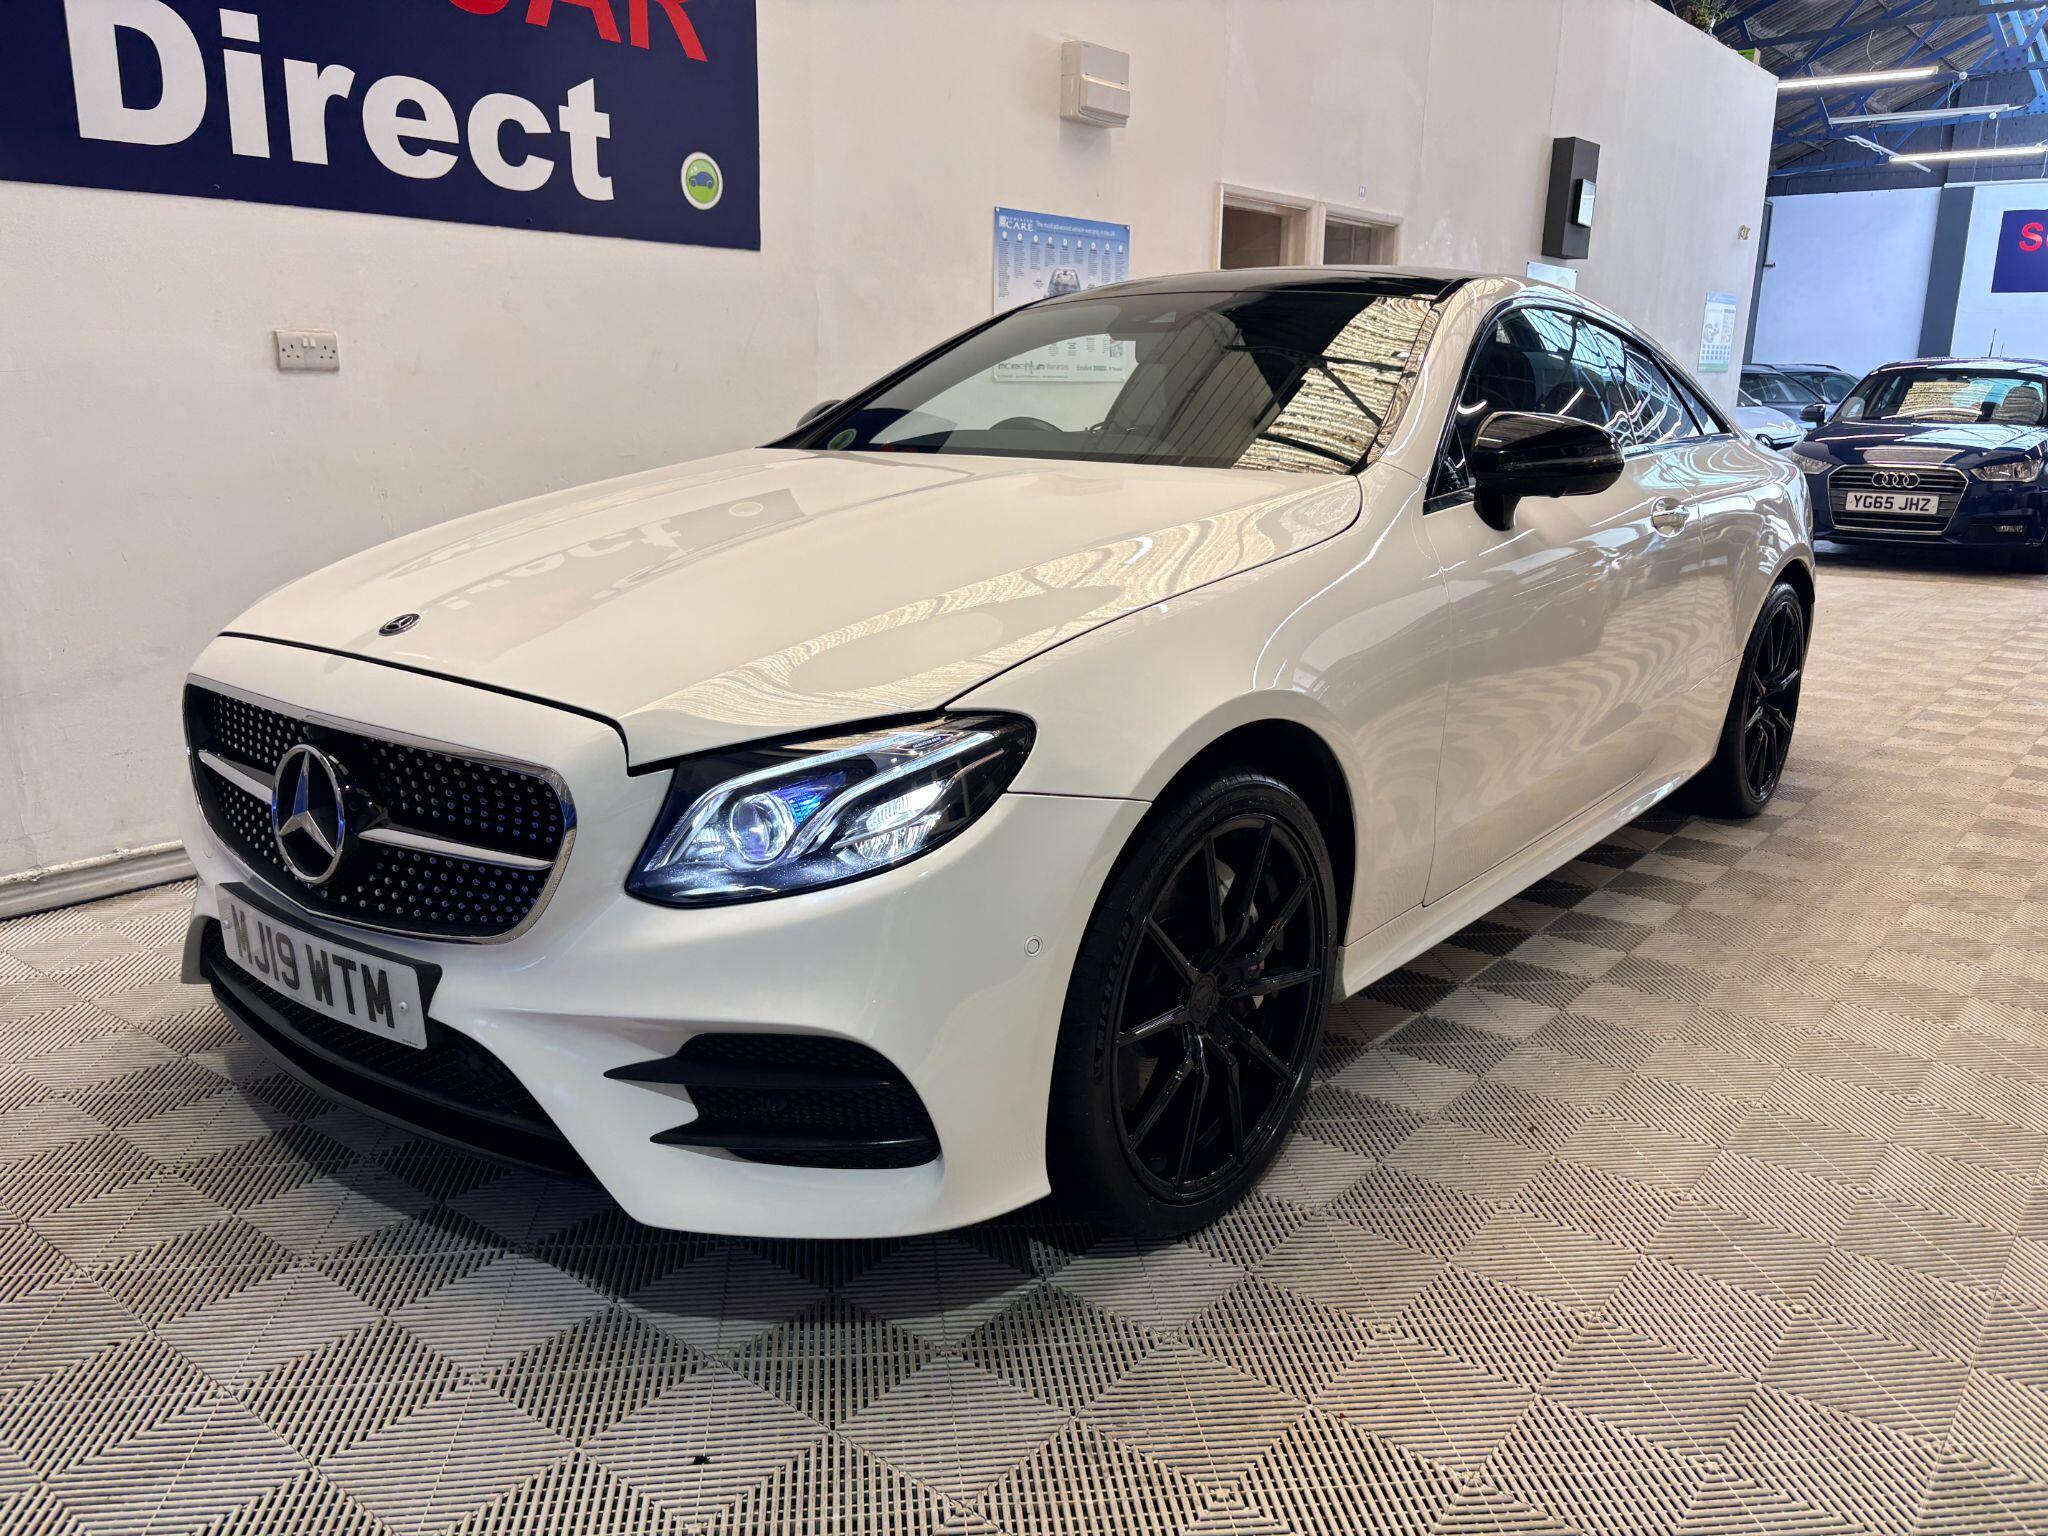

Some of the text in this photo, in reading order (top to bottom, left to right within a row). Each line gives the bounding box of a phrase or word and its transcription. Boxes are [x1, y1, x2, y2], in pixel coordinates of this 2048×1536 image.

[449, 0, 708, 62] AR
[64, 0, 616, 202] Direct
[1006, 220, 1033, 232] CARE
[2018, 221, 2048, 252] S
[1854, 494, 1931, 512] YG65 JHZ
[231, 904, 395, 1029] MJ19 WTM
[1095, 911, 1136, 1050] MICHELIN
